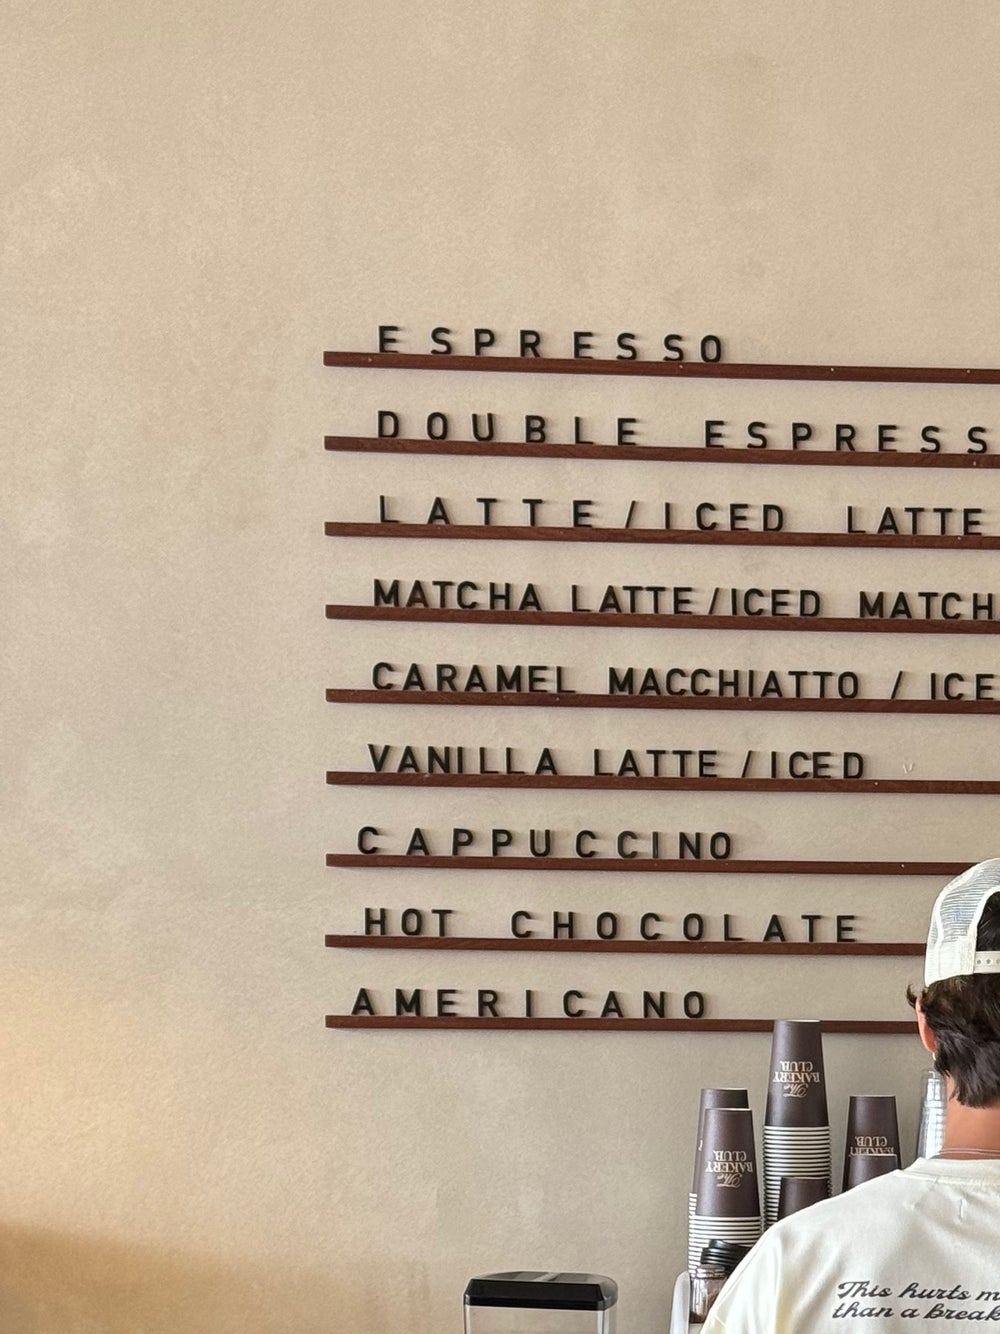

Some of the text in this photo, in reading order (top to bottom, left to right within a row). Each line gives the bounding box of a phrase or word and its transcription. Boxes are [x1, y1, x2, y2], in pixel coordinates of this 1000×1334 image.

[378, 326, 723, 363] ESPRESSO
[377, 410, 639, 446] DOUBLE
[379, 495, 786, 533] LATTE/ICED
[847, 506, 984, 536] LATTE
[373, 579, 543, 612] MATCHA
[571, 584, 823, 618] LATTE/ICED
[371, 662, 576, 696] CARAMEL
[608, 666, 861, 700] MACCHIATTO
[367, 743, 559, 776] VANILLA
[357, 826, 732, 860] CAPPUCCINO
[364, 907, 454, 937] HOT
[510, 910, 857, 944] CHOCOLATE
[351, 987, 706, 1019] AMERICANO
[772, 1071, 820, 1083] BAKERY
[783, 1082, 809, 1098] The
[705, 1161, 753, 1173] BAKERY
[716, 1172, 744, 1188] The
[837, 1280, 893, 1299] This
[898, 1282, 972, 1301] hurts
[832, 1301, 895, 1319] than
[900, 1308, 920, 1318] a
